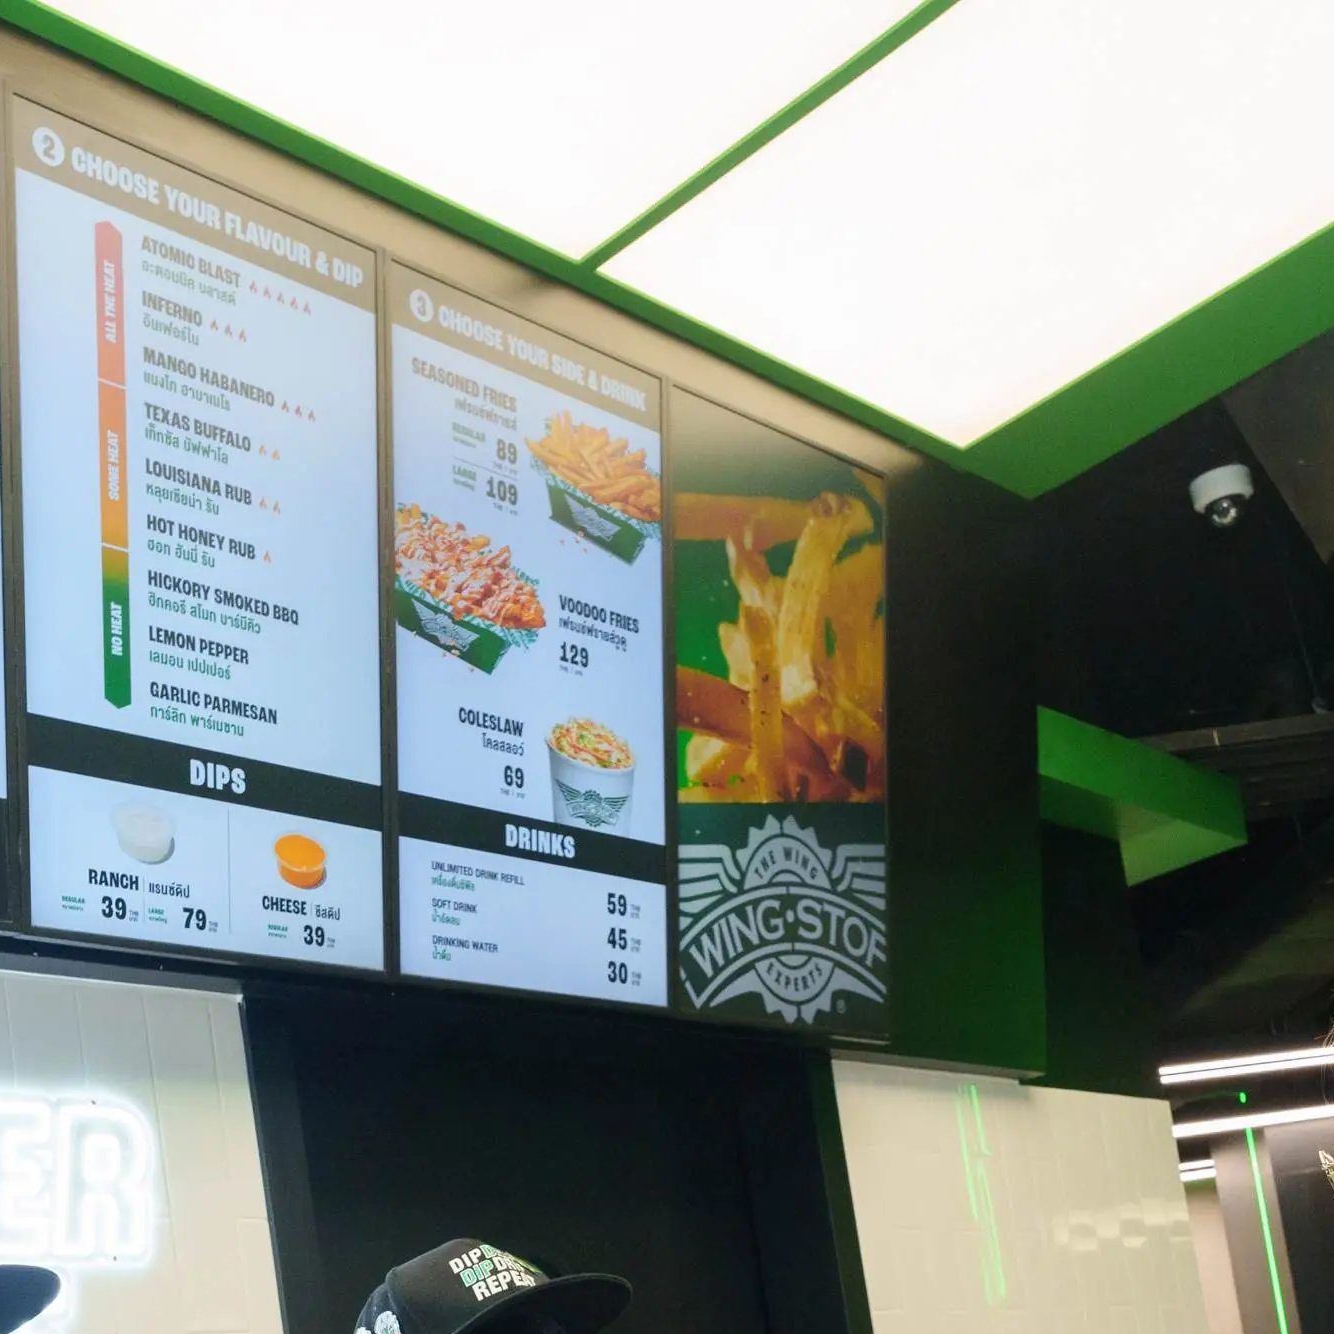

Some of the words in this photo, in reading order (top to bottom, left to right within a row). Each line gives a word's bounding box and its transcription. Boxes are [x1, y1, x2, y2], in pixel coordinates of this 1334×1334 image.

[71, 146, 161, 206] CHOOSE
[164, 184, 222, 231] YOUR
[224, 208, 312, 270] FLAVOUR
[316, 250, 330, 276] &
[332, 256, 364, 289] DIP
[141, 235, 195, 269] ATOMIC
[198, 257, 241, 288] BLAST
[142, 291, 203, 327] INFERNO
[438, 305, 505, 351] CHOOSE
[507, 333, 549, 371] YOUR
[551, 353, 585, 386] SIDE
[600, 375, 647, 412] DRINK
[143, 346, 197, 380] MANGO
[199, 366, 275, 407] HABANERO
[411, 356, 480, 399] SEASONED
[482, 385, 518, 413] FRIES
[144, 402, 191, 432] TEXAS
[194, 419, 251, 452] BUFFALO
[496, 438, 518, 465] 89
[145, 458, 222, 496] LOUISIANA
[225, 483, 253, 506] RUB
[486, 476, 518, 506] 109
[146, 513, 175, 536] HOT
[178, 524, 225, 552] HONEY
[229, 540, 256, 560] RUB
[147, 569, 211, 601] HICKORY
[214, 588, 270, 617] SMOKED
[273, 603, 299, 626] BBQ
[559, 594, 608, 623] VOODOO
[609, 607, 639, 634] FRIES
[149, 625, 196, 651] LEMON
[199, 639, 249, 665] PEPPER
[559, 643, 589, 668] 129
[150, 681, 200, 707] GARLIC
[204, 693, 277, 725] PARMESAN
[458, 707, 524, 737] COLESLAW
[189, 758, 247, 794] DIPS
[503, 765, 525, 788] 69
[505, 823, 576, 859] DRINKS
[431, 861, 474, 877] UNLIMITED
[755, 850, 777, 880] THE
[782, 846, 818, 880] WING
[88, 868, 139, 891] RANCH
[101, 895, 127, 921] 39
[182, 907, 207, 931] 79
[262, 895, 307, 916] CHEESE
[607, 892, 627, 917] 59
[303, 924, 325, 948] 39
[432, 935, 470, 950] DRINKING
[472, 941, 498, 953] WATER
[607, 927, 628, 950] 45
[608, 961, 628, 985] 30
[766, 962, 823, 992] EXPERTS
[449, 1248, 482, 1274] DIP
[460, 1260, 494, 1287] DIP
[472, 1269, 536, 1302] REPEAT
